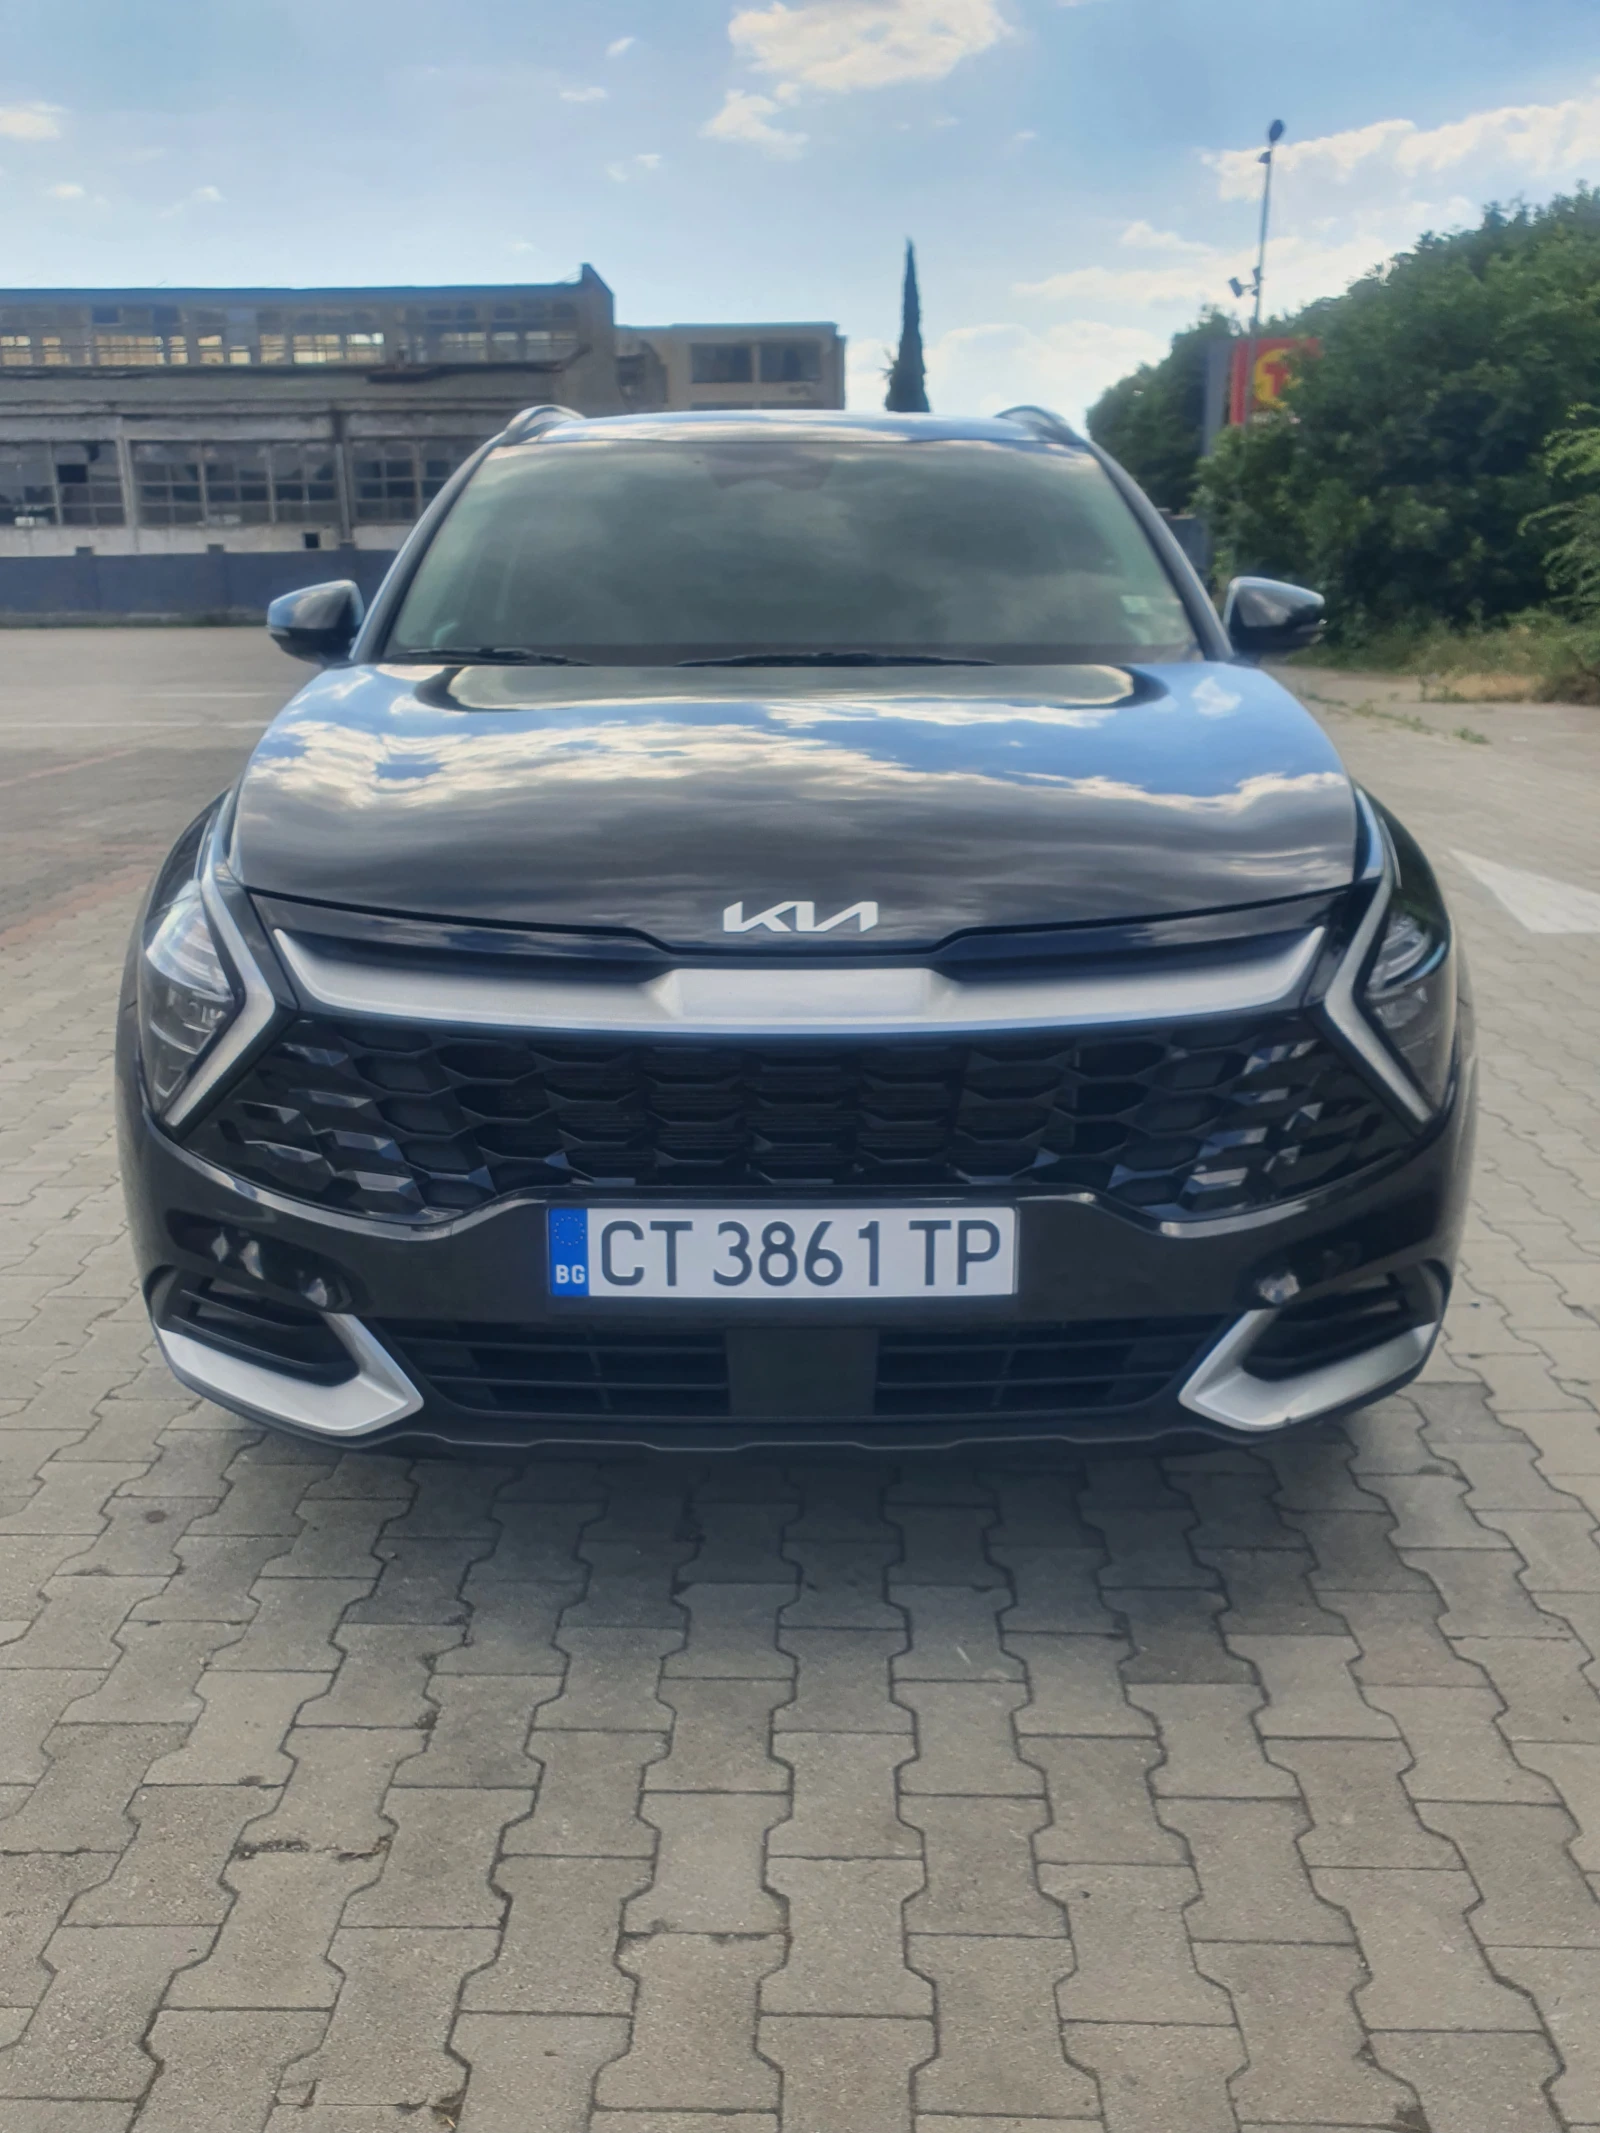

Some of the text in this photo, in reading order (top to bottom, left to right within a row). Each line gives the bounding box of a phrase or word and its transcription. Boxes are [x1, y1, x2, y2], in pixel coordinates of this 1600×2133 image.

[723, 901, 879, 932] KIA
[601, 1220, 1001, 1287] CT 3861 TP
[556, 1264, 586, 1284] BG
